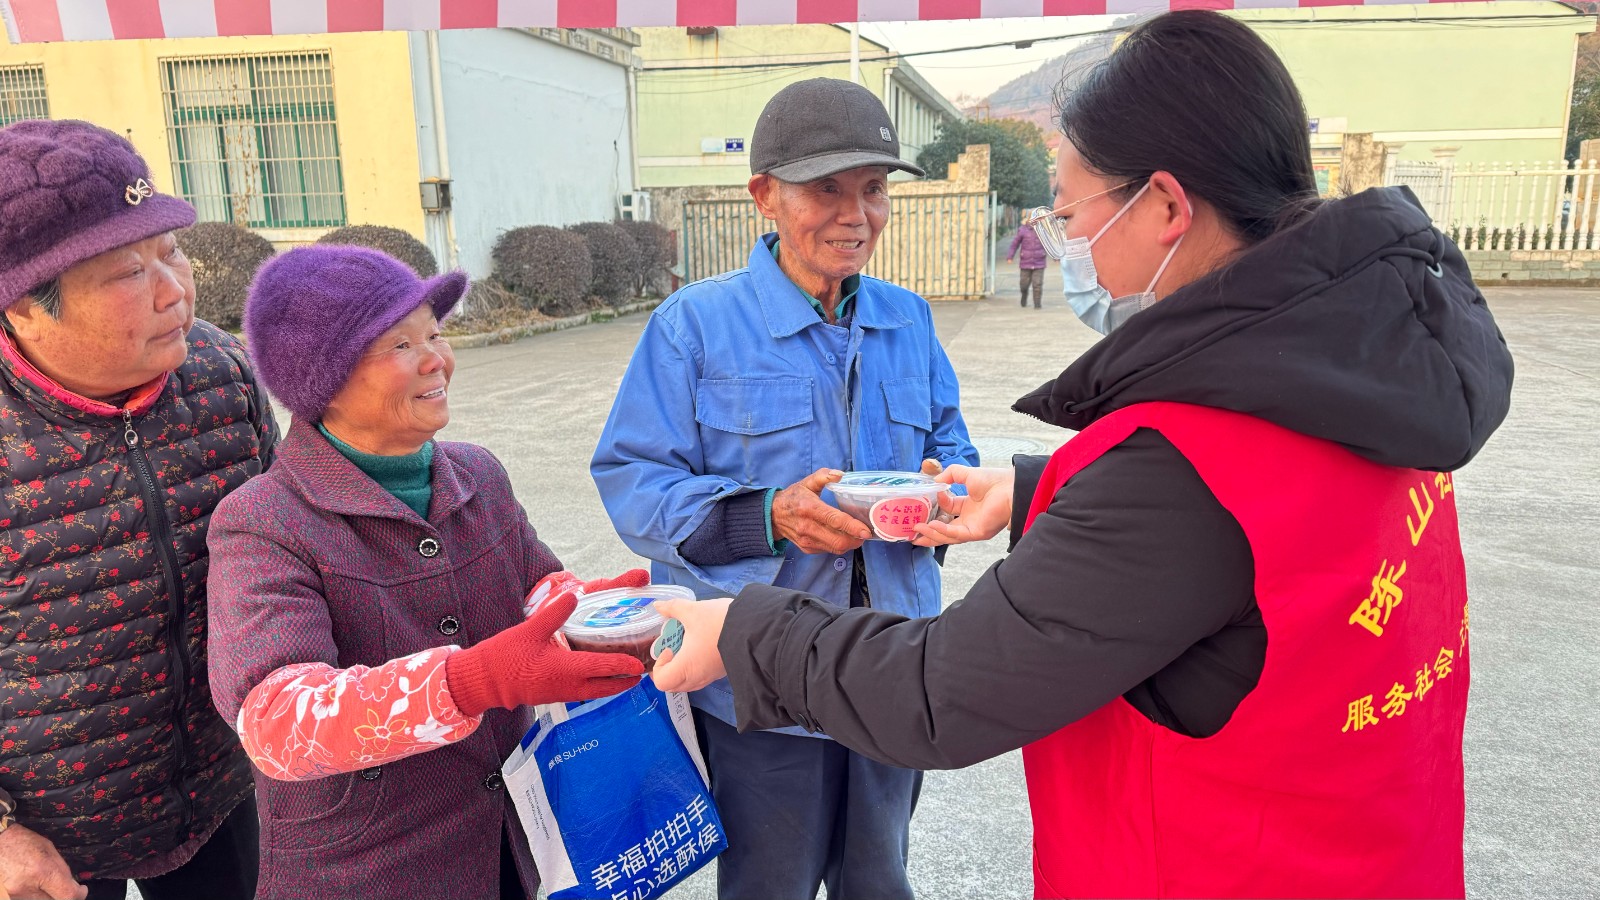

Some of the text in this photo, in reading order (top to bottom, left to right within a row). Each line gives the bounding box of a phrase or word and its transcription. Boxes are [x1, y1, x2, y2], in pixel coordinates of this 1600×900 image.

[1341, 646, 1454, 733] 服务社会
[562, 739, 599, 760] SU-HOO
[590, 794, 709, 891] 幸福拍拍手
